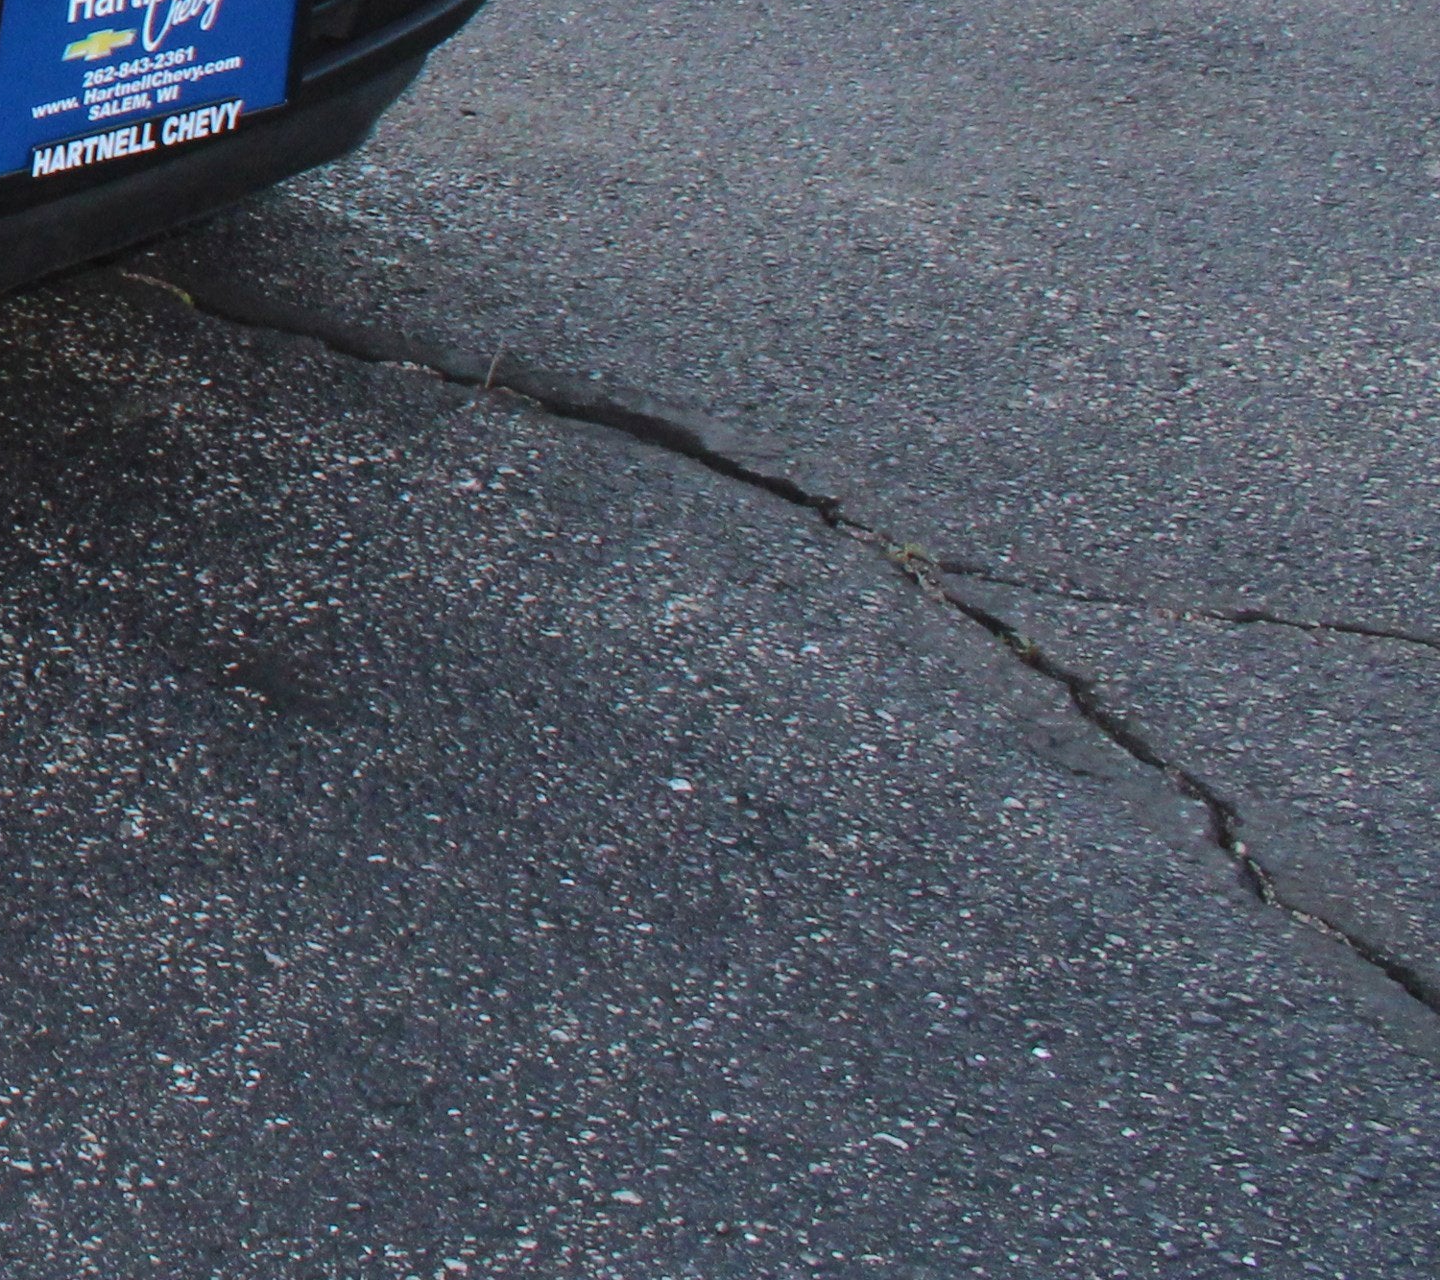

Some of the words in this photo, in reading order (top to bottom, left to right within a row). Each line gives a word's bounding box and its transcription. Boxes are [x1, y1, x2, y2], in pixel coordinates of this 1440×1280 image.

[31, 95, 79, 119] www.
[83, 55, 241, 106] HartnellChevy.com
[82, 46, 195, 88] 262-843-2361
[87, 92, 152, 121] SALEM,
[156, 84, 180, 104] WI
[32, 122, 156, 178] HARTNELL
[161, 99, 244, 146] CHEVY
